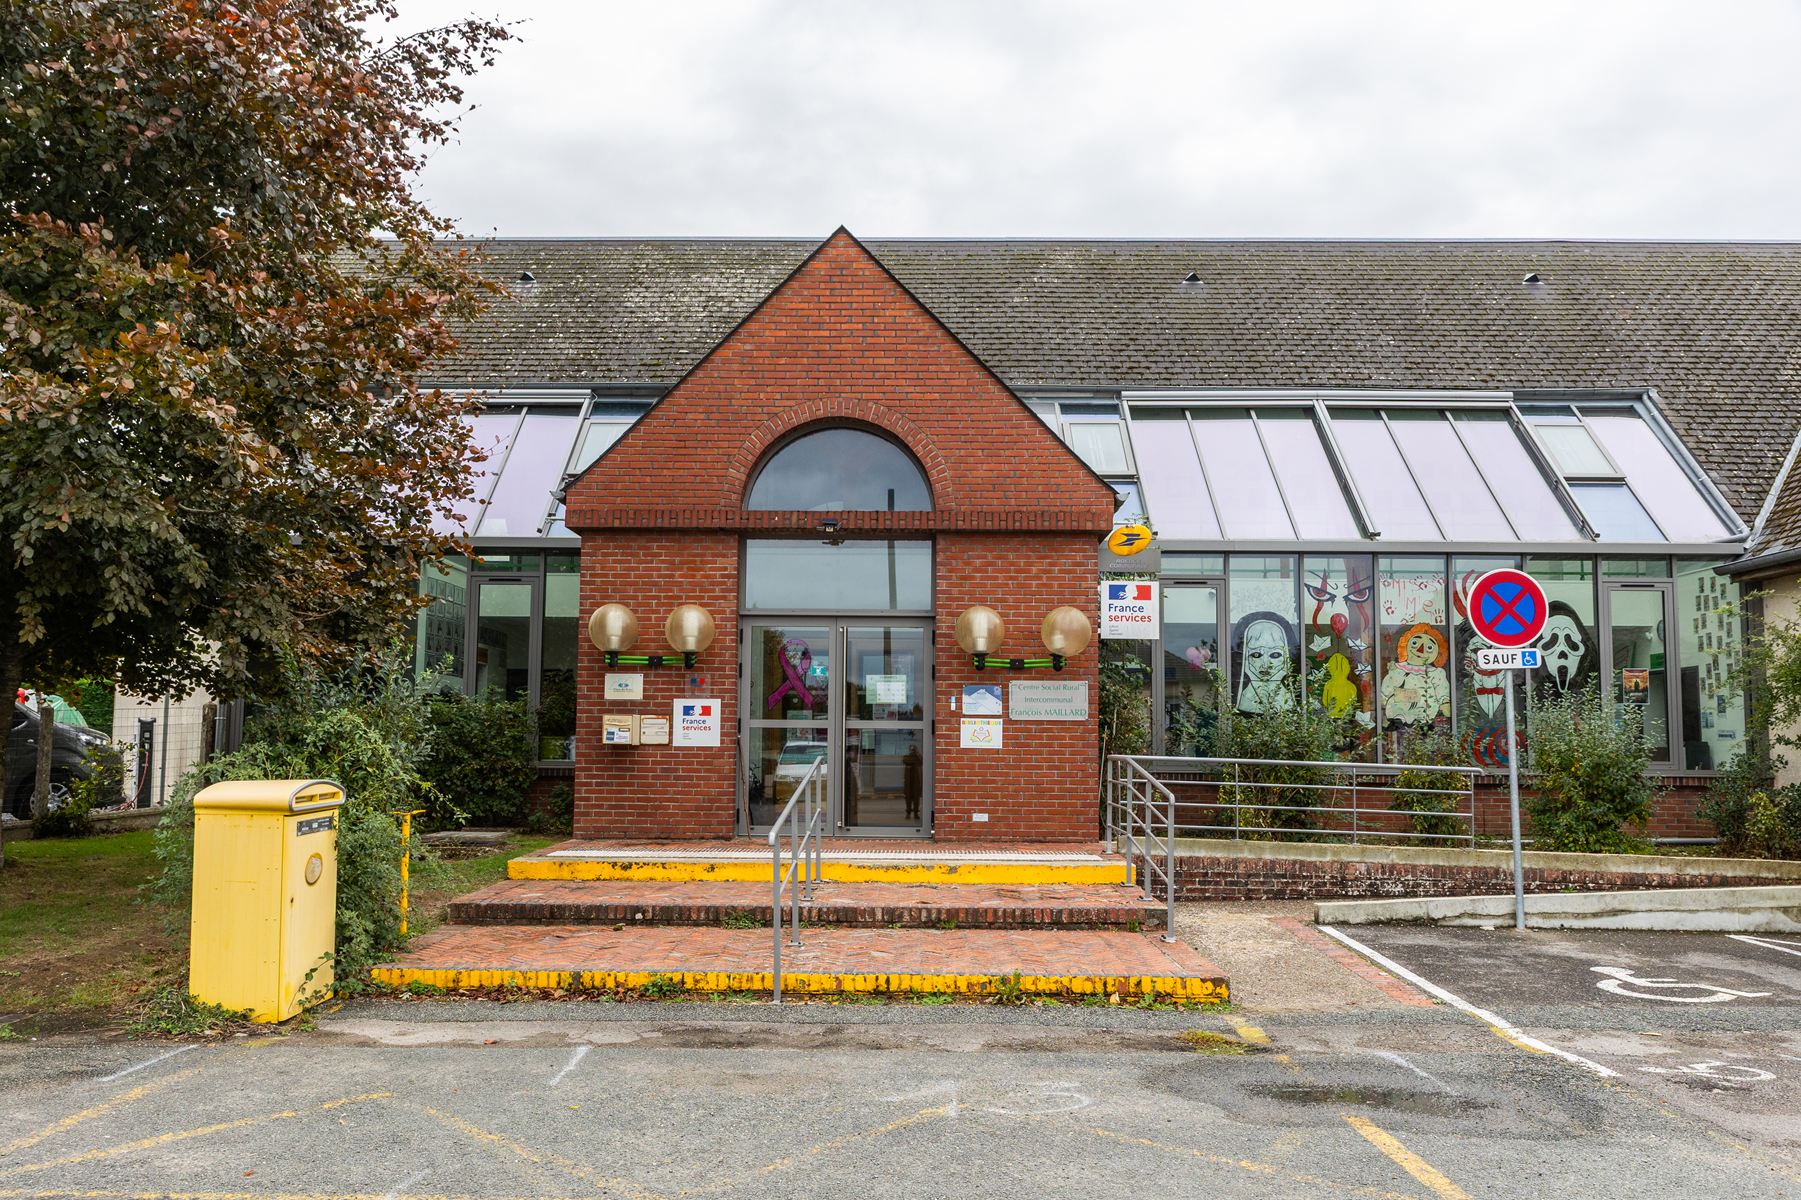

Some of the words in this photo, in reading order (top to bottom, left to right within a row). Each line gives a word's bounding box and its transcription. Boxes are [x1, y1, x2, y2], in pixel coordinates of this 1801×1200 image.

[1108, 603, 1145, 613] France
[1108, 613, 1152, 623] services
[1482, 653, 1518, 665] SAUF
[1017, 683, 1040, 691] Centre
[1041, 683, 1061, 691] Social
[1062, 683, 1080, 691] Rural
[1011, 708, 1043, 717] François
[1044, 708, 1087, 717] MAILLARD
[682, 717, 707, 725] France
